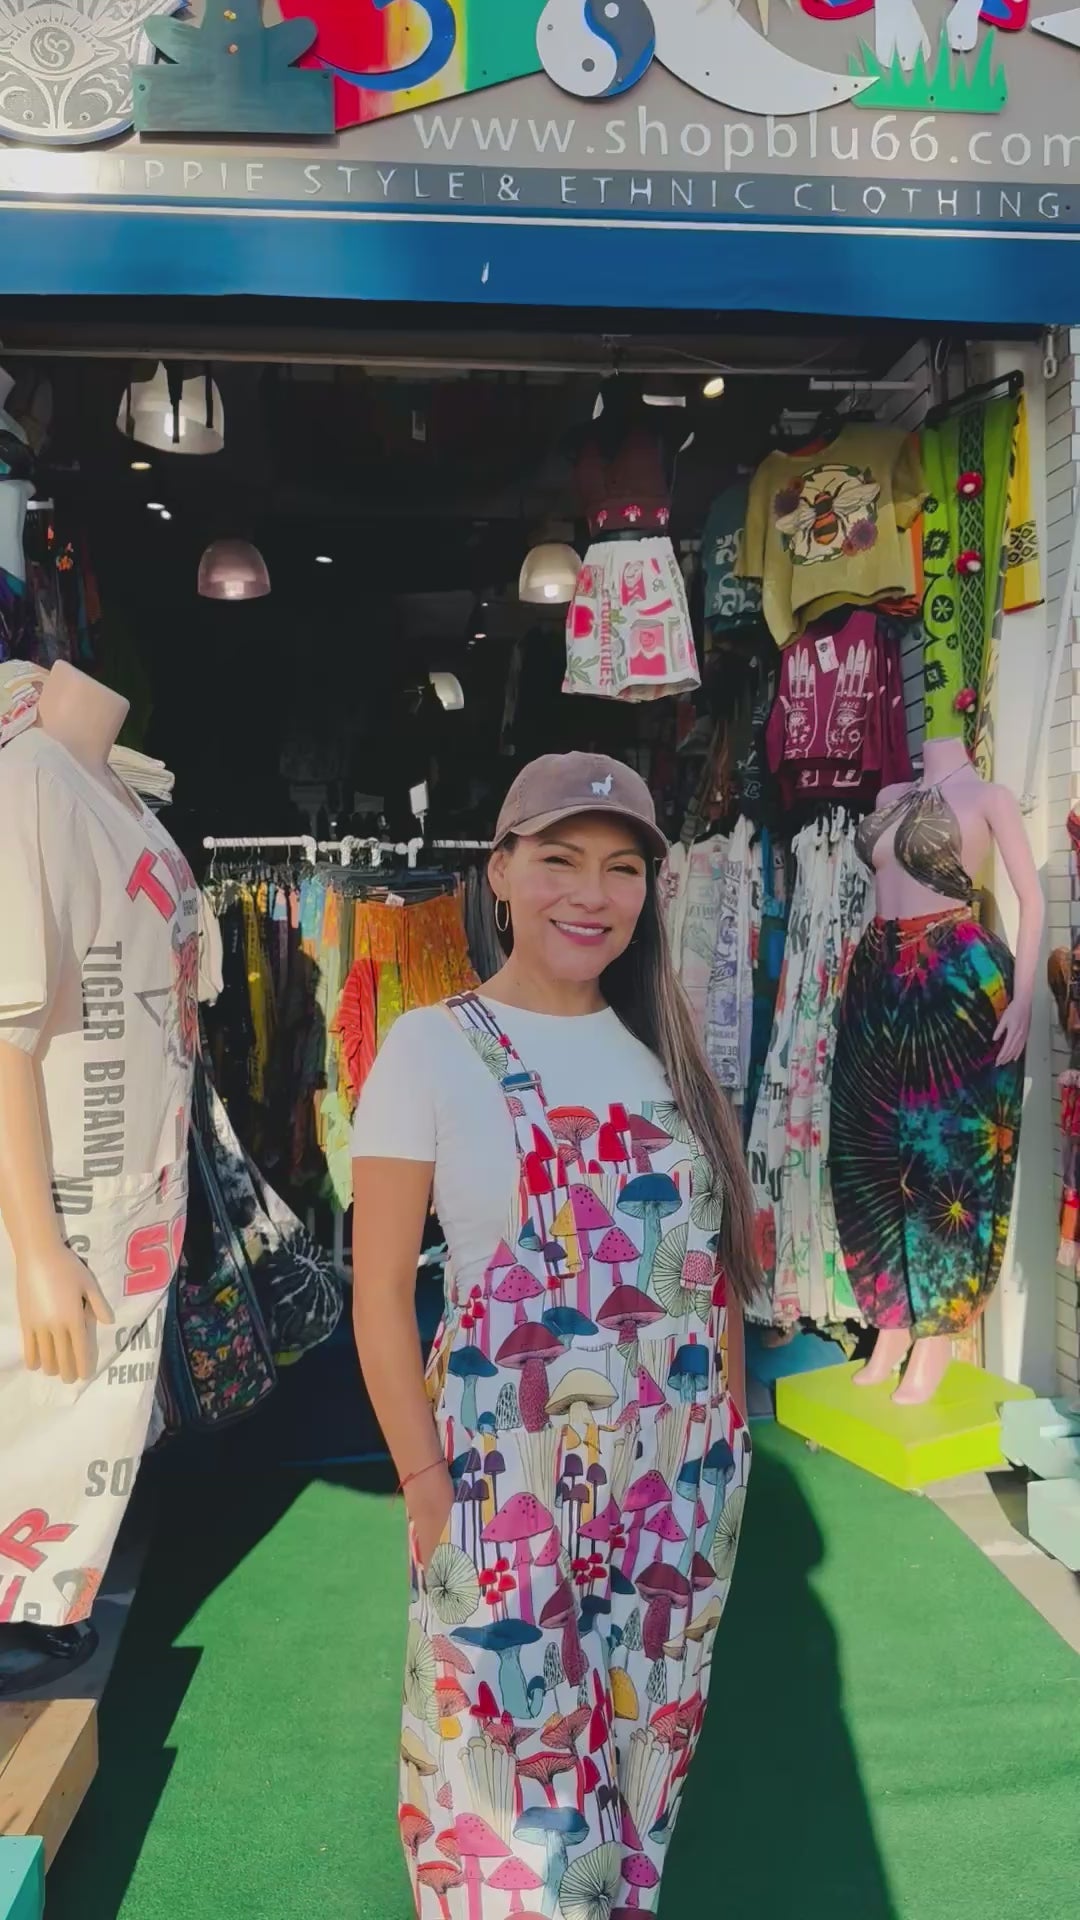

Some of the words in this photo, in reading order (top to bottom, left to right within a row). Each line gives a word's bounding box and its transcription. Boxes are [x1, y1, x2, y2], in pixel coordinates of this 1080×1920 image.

[413, 105, 1080, 171] www.shopblu66.com
[98, 158, 264, 192] IPPIE
[303, 164, 464, 199] STYLE
[497, 173, 520, 200] &
[560, 175, 756, 209] ETHNIC
[794, 182, 1060, 219] CLOTHING
[81, 940, 125, 1041] TIGER
[83, 1059, 125, 1177] BRAND
